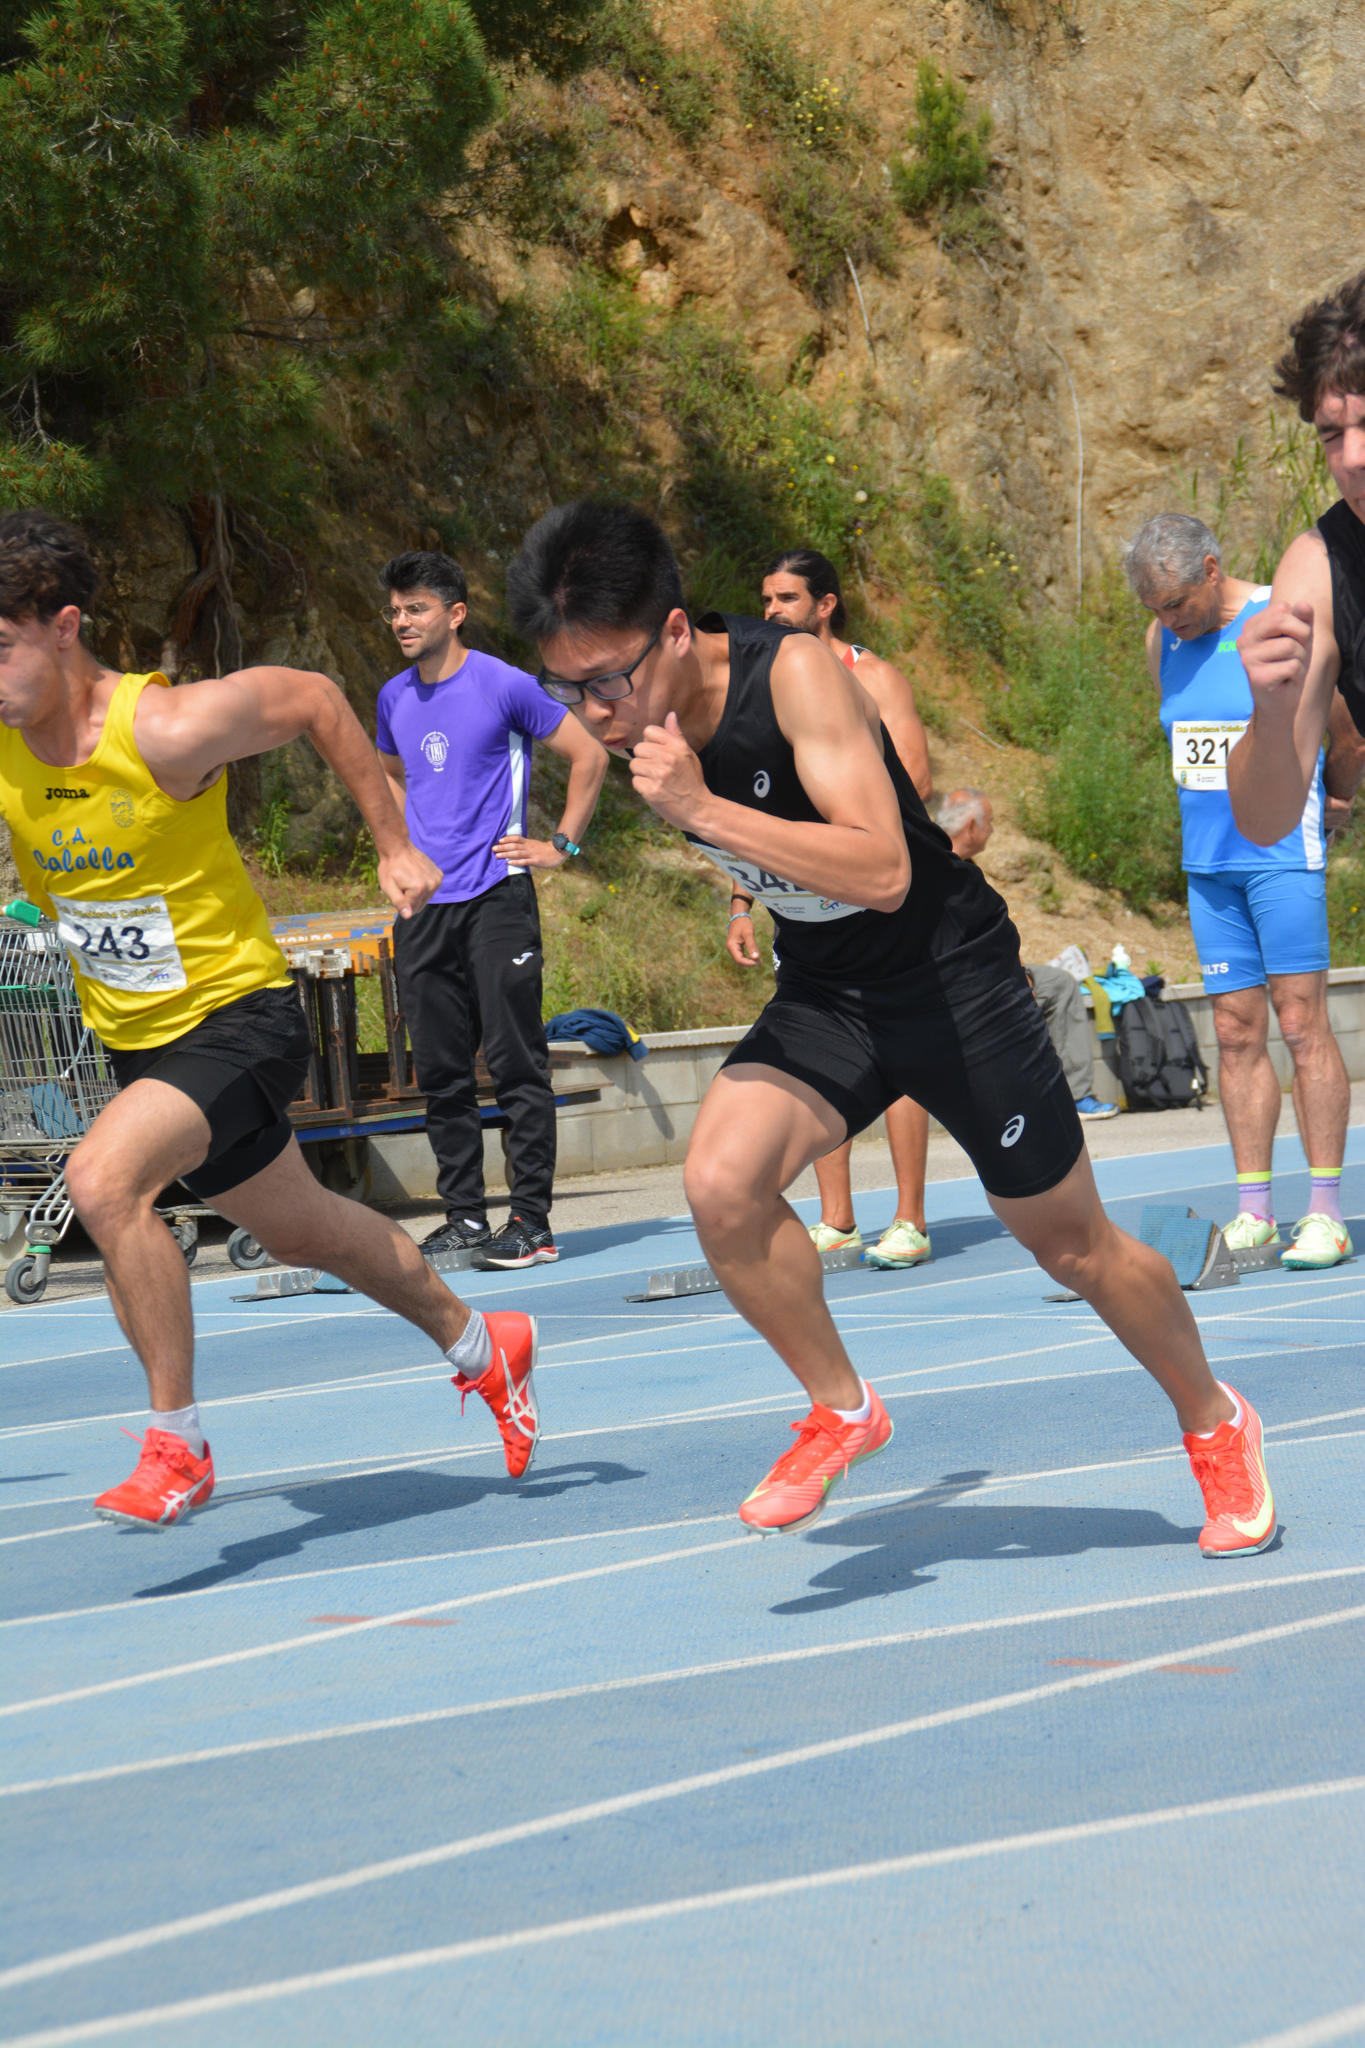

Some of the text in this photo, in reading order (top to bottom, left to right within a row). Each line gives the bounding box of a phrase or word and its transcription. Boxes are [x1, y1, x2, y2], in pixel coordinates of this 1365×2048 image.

[1186, 737, 1229, 765] 321
[52, 826, 93, 846] C.A.
[727, 865, 808, 893] 34
[73, 925, 151, 960] 243
[1202, 961, 1230, 975] LTS
